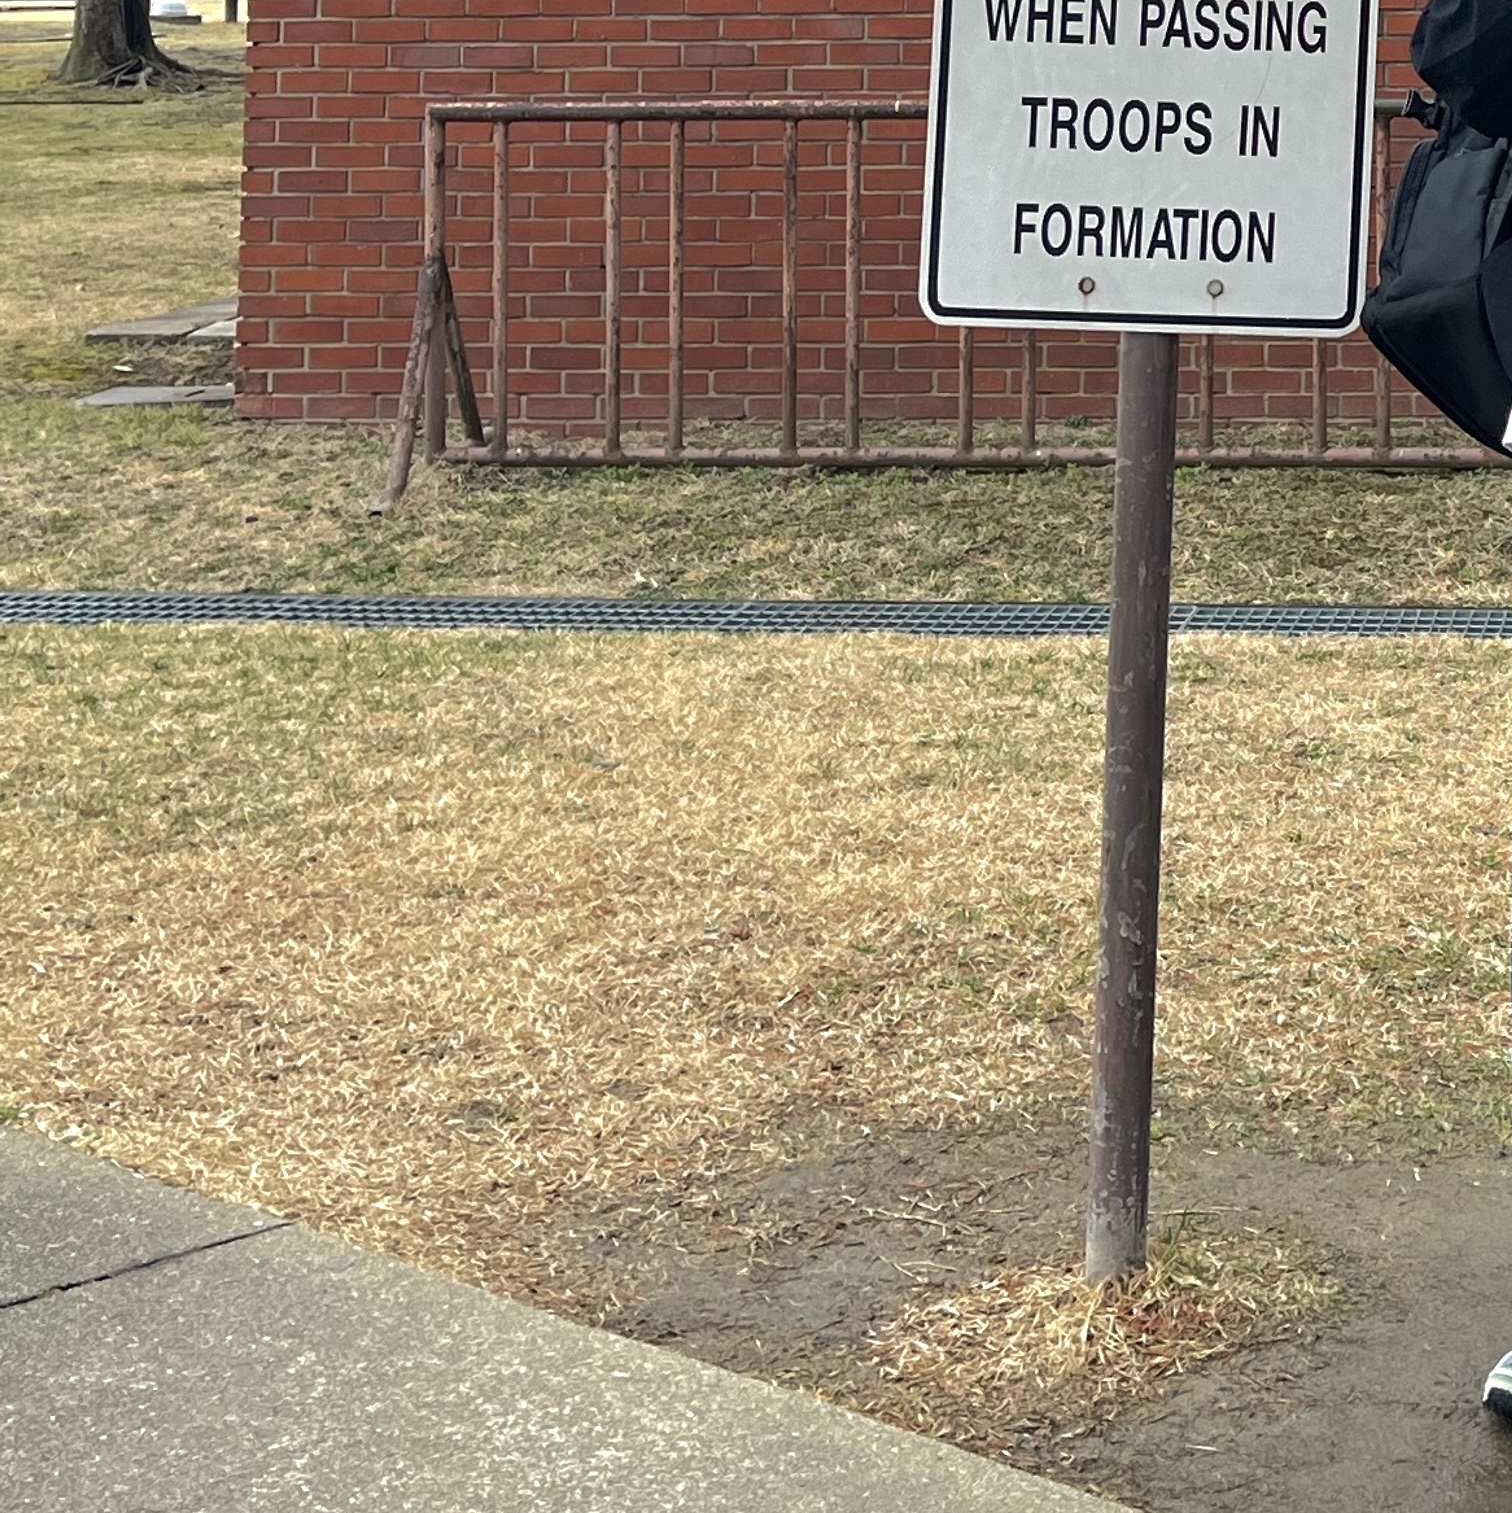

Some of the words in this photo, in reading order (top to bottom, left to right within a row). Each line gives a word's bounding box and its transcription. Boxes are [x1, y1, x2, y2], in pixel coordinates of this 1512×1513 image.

[1021, 96, 1212, 155] TROOPS
[1239, 104, 1280, 158] IN
[1013, 203, 1276, 263] FORMATION
